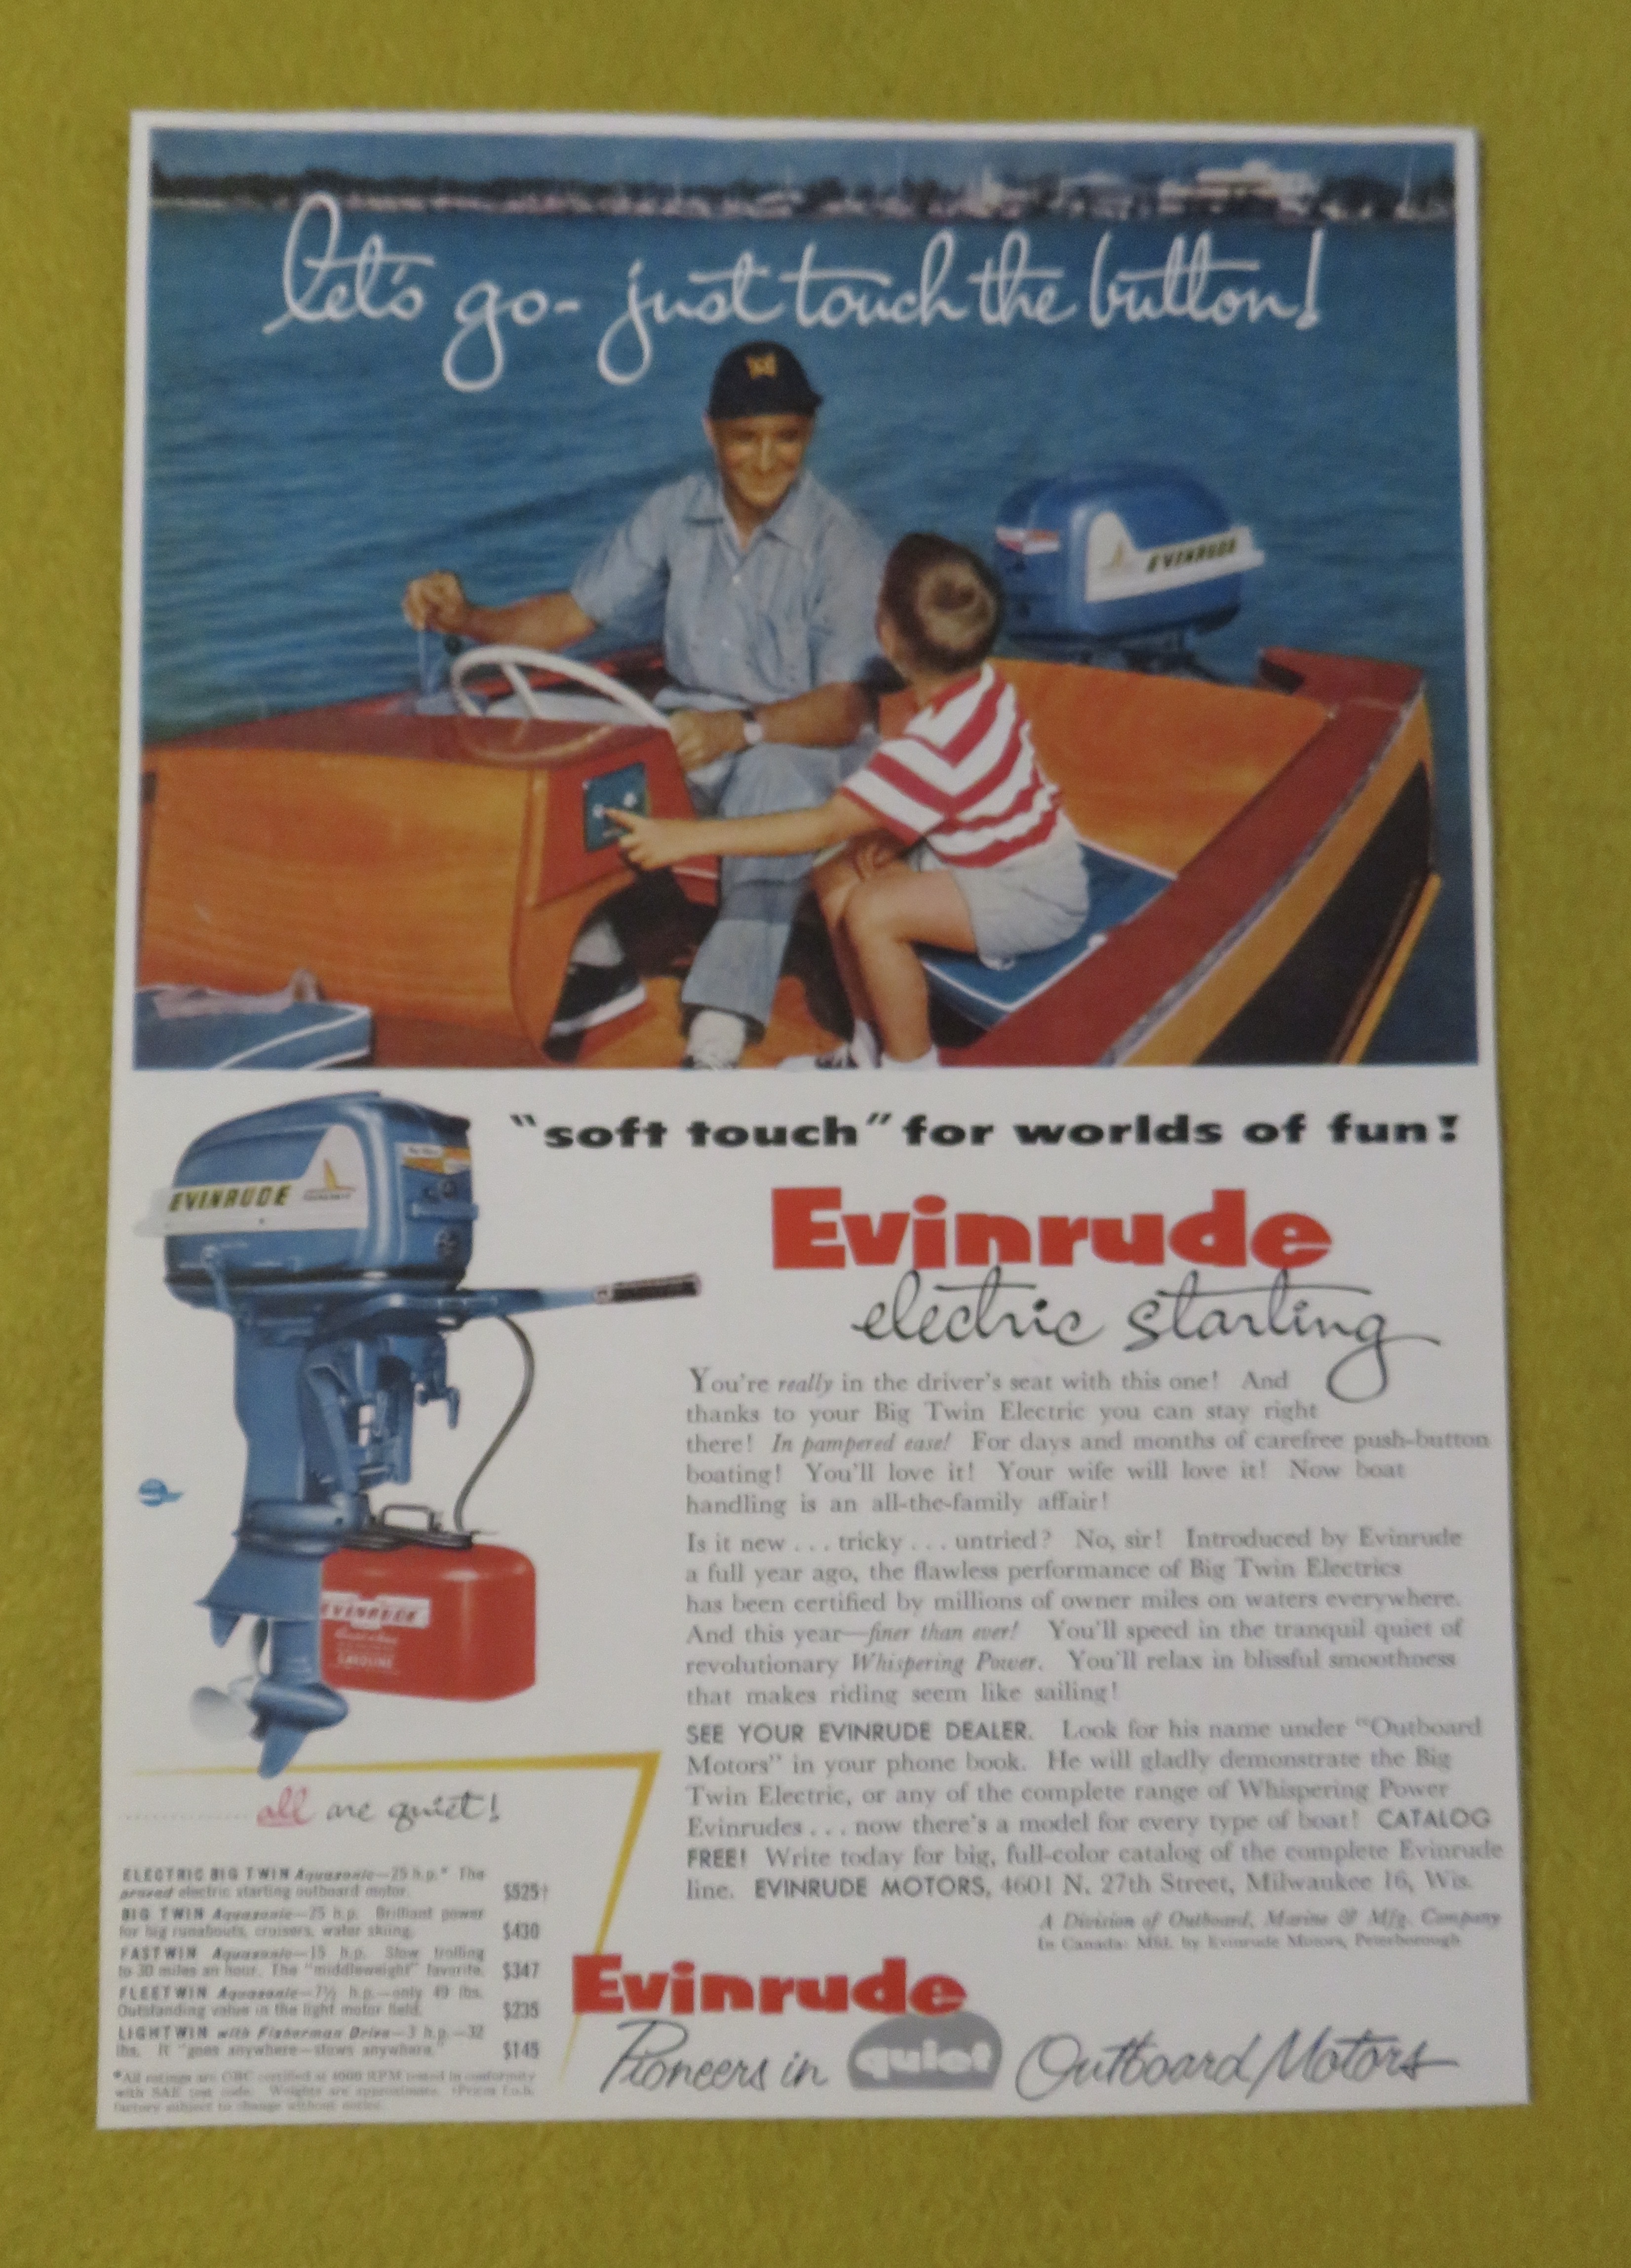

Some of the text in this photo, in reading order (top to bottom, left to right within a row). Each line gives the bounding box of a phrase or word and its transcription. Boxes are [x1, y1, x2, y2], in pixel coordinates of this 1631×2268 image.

[597, 249, 785, 386] just
[778, 228, 970, 327] touch
[967, 230, 1077, 326] the
[1089, 229, 1324, 330] button!
[510, 1113, 1460, 1148] “soft touch” for worlds of fun!
[168, 1184, 292, 1213] EVINRUDE
[772, 1186, 1331, 1269] Evinrude
[851, 1265, 1440, 1404] electric starting
[689, 1368, 1289, 1397] You're really in the driver's seat with this one! And
[687, 1399, 1318, 1427] thanks to your Big Twin Electric you can stay right
[687, 1428, 1491, 1457] there! In pampered ease! For days and months of carefree push-button
[687, 1459, 1405, 1489] boating! You'll love it! Your wife will love it! Now boat
[687, 1490, 1108, 1519] handling is an all-the-family affair!
[687, 1648, 1457, 1679] revolutionary Whispering Power. You'll relax in blissful smoothness
[687, 1680, 1118, 1707] that makes riding seem like sailing!
[687, 1723, 724, 1745] SEE
[738, 1722, 805, 1744] YOUR
[819, 1720, 932, 1743] EVINRUDE
[946, 1719, 1034, 1741] DEALER.
[1063, 1718, 1118, 1740] Look
[1128, 1718, 1159, 1739] for
[1169, 1718, 1200, 1738] his
[1209, 1723, 1271, 1738] name
[1281, 1717, 1347, 1737] under
[257, 1785, 500, 1833] all are quiet!
[688, 1838, 1504, 1871] FREE! Write today for big, full-color catalog of the complete Evinrude
[687, 1878, 734, 1900] line.
[755, 1876, 868, 1899] EVINRUDE
[881, 1874, 992, 1899] MOTORS,
[1001, 1875, 1051, 1895] 4601
[1064, 1873, 1090, 1895] N.
[1101, 1872, 1151, 1894] 27th
[1162, 1872, 1235, 1896] Street,
[1247, 1870, 1372, 1892] Milwaukee
[121, 1907, 151, 1922] BIG
[160, 1906, 205, 1921] TWIN
[503, 1921, 540, 1941] $430
[503, 1960, 540, 1981] $347
[572, 1955, 967, 2015] Evinrude
[503, 2000, 539, 2021] $235
[503, 2039, 539, 2060] $145
[600, 2017, 1458, 2102] Pioneers in quiet Outboard Motors
